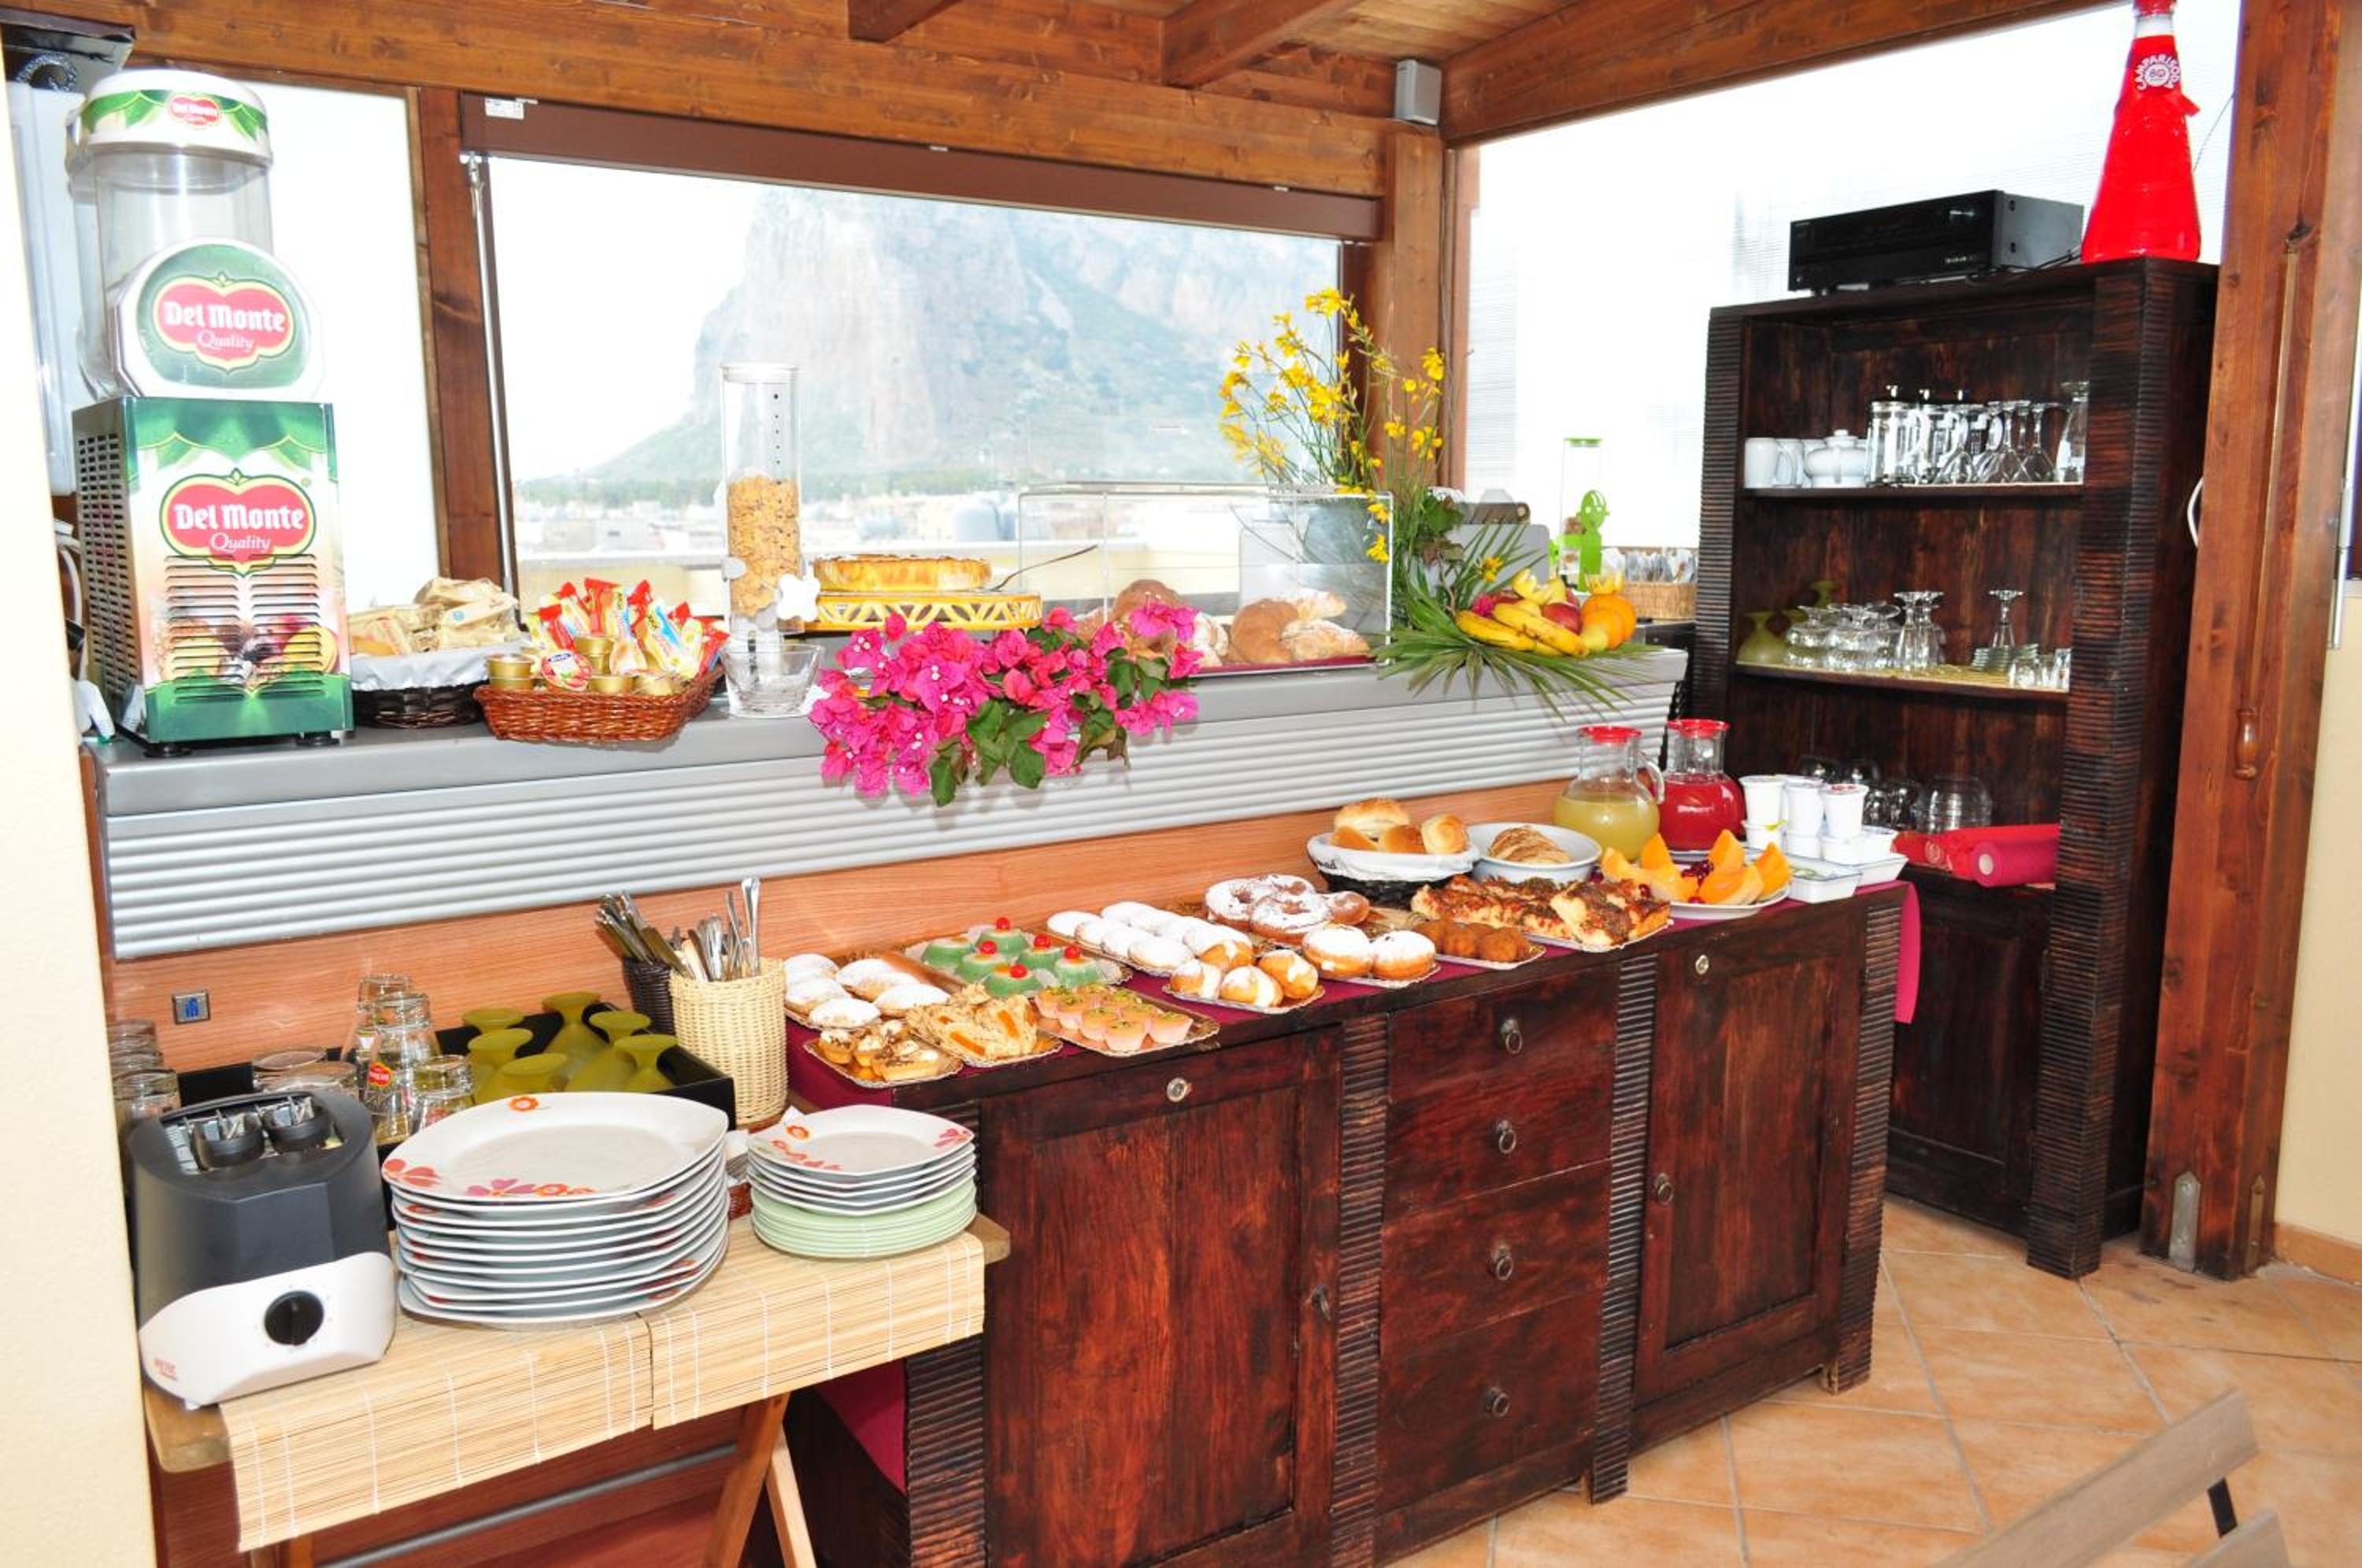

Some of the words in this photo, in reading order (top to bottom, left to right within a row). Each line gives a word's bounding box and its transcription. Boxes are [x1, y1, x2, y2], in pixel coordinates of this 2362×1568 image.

[164, 301, 205, 327] Del
[208, 304, 286, 332] Monte
[198, 330, 254, 353] Quality
[174, 503, 219, 530] Del
[220, 503, 305, 530] Monte
[211, 531, 271, 553] Quality
